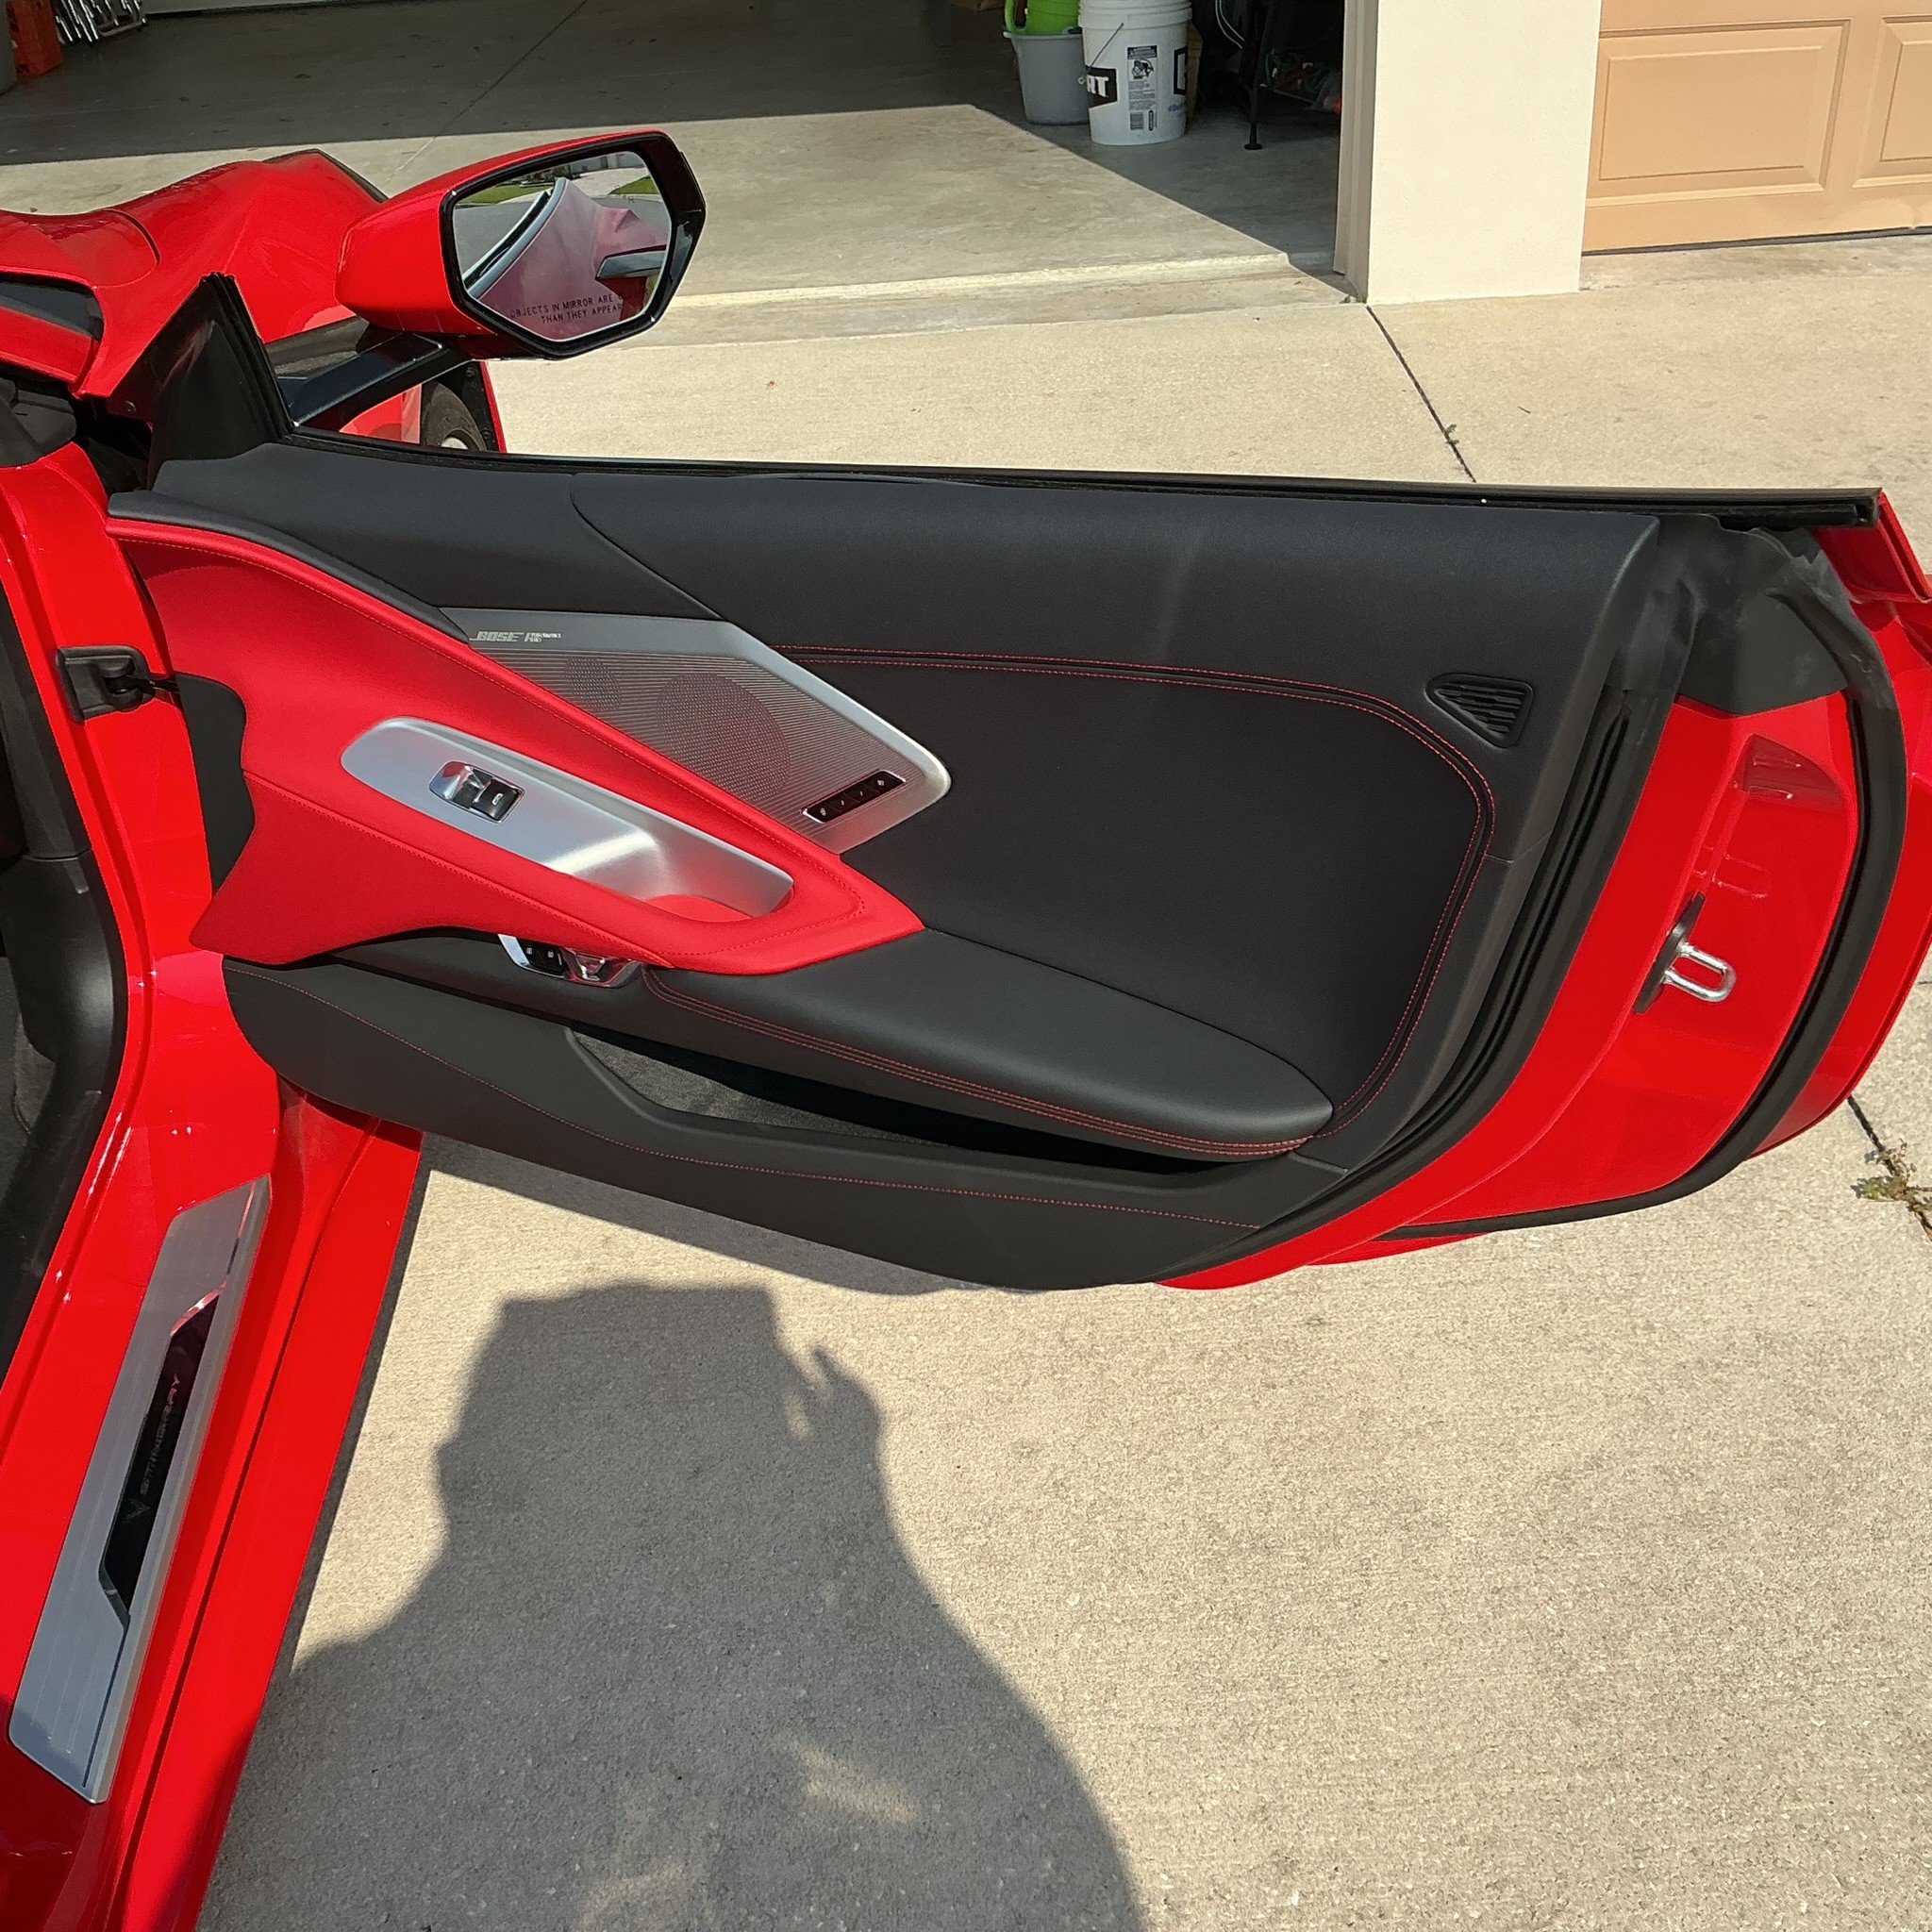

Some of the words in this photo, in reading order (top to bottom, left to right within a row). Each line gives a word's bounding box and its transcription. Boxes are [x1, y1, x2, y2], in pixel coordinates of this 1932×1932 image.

[509, 305, 549, 319] OBJECTS
[552, 303, 560, 311] IN
[562, 297, 593, 309] MIRROR
[598, 293, 613, 303] ARE
[541, 313, 563, 324] THAN
[566, 309, 587, 320] THEY
[469, 630, 525, 642] BOSE
[140, 1374, 180, 1496] STINGRAY
